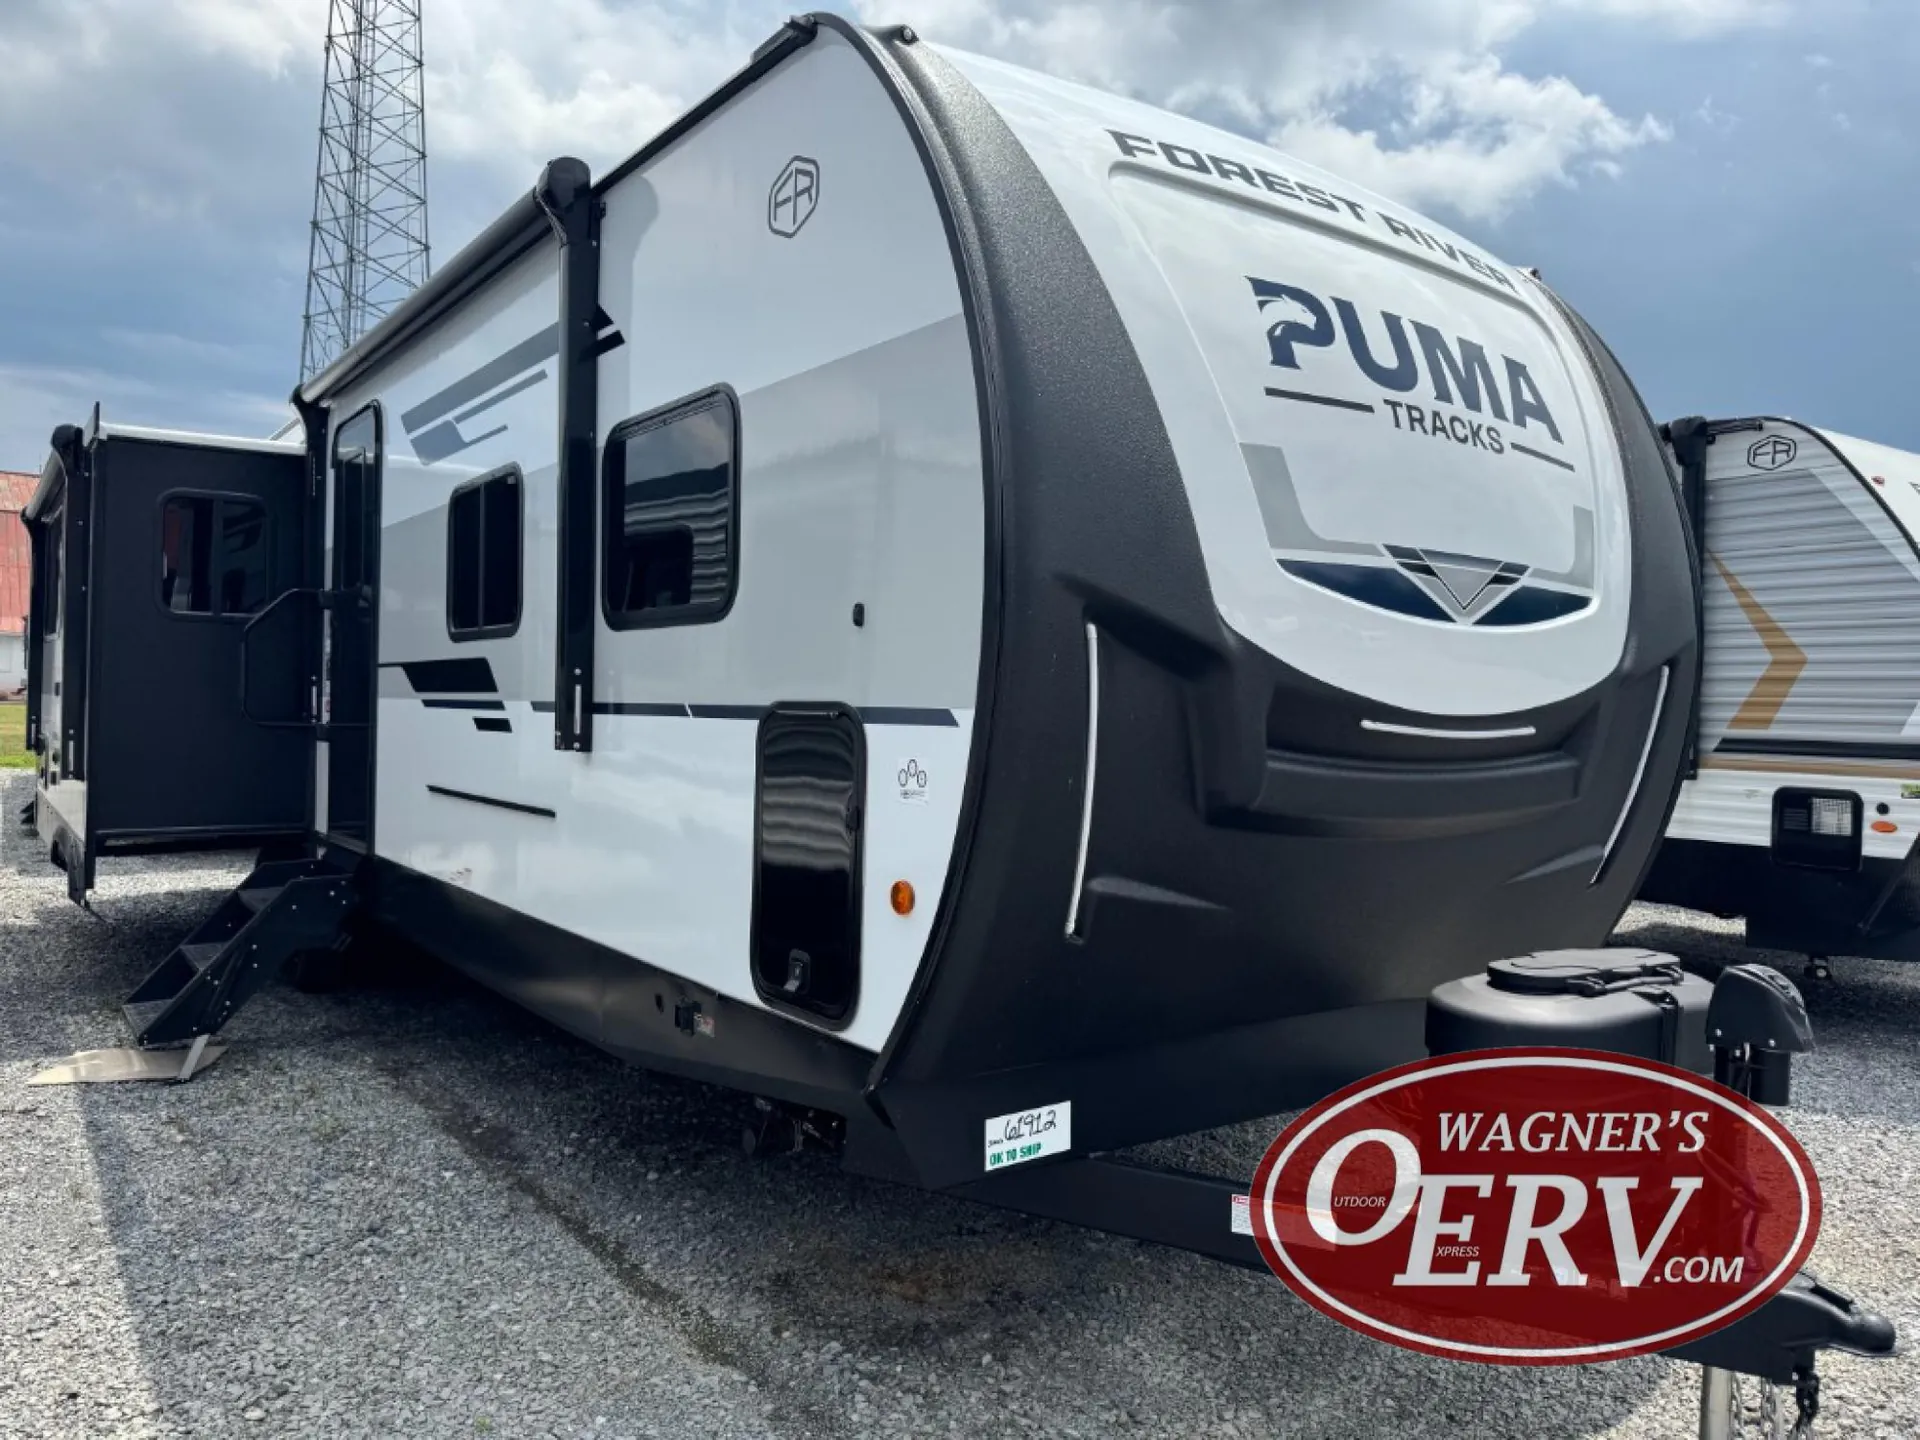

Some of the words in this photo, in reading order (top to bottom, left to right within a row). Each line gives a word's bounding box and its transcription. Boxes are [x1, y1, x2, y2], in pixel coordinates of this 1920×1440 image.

[1105, 129, 1367, 222] FOREST
[1376, 211, 1519, 294] RIVER
[1244, 275, 1564, 445] PUMA
[1384, 399, 1506, 455] TRACKS
[989, 1152, 1004, 1166] OK
[1006, 1148, 1018, 1162] TO
[1019, 1142, 1042, 1158] SHIP
